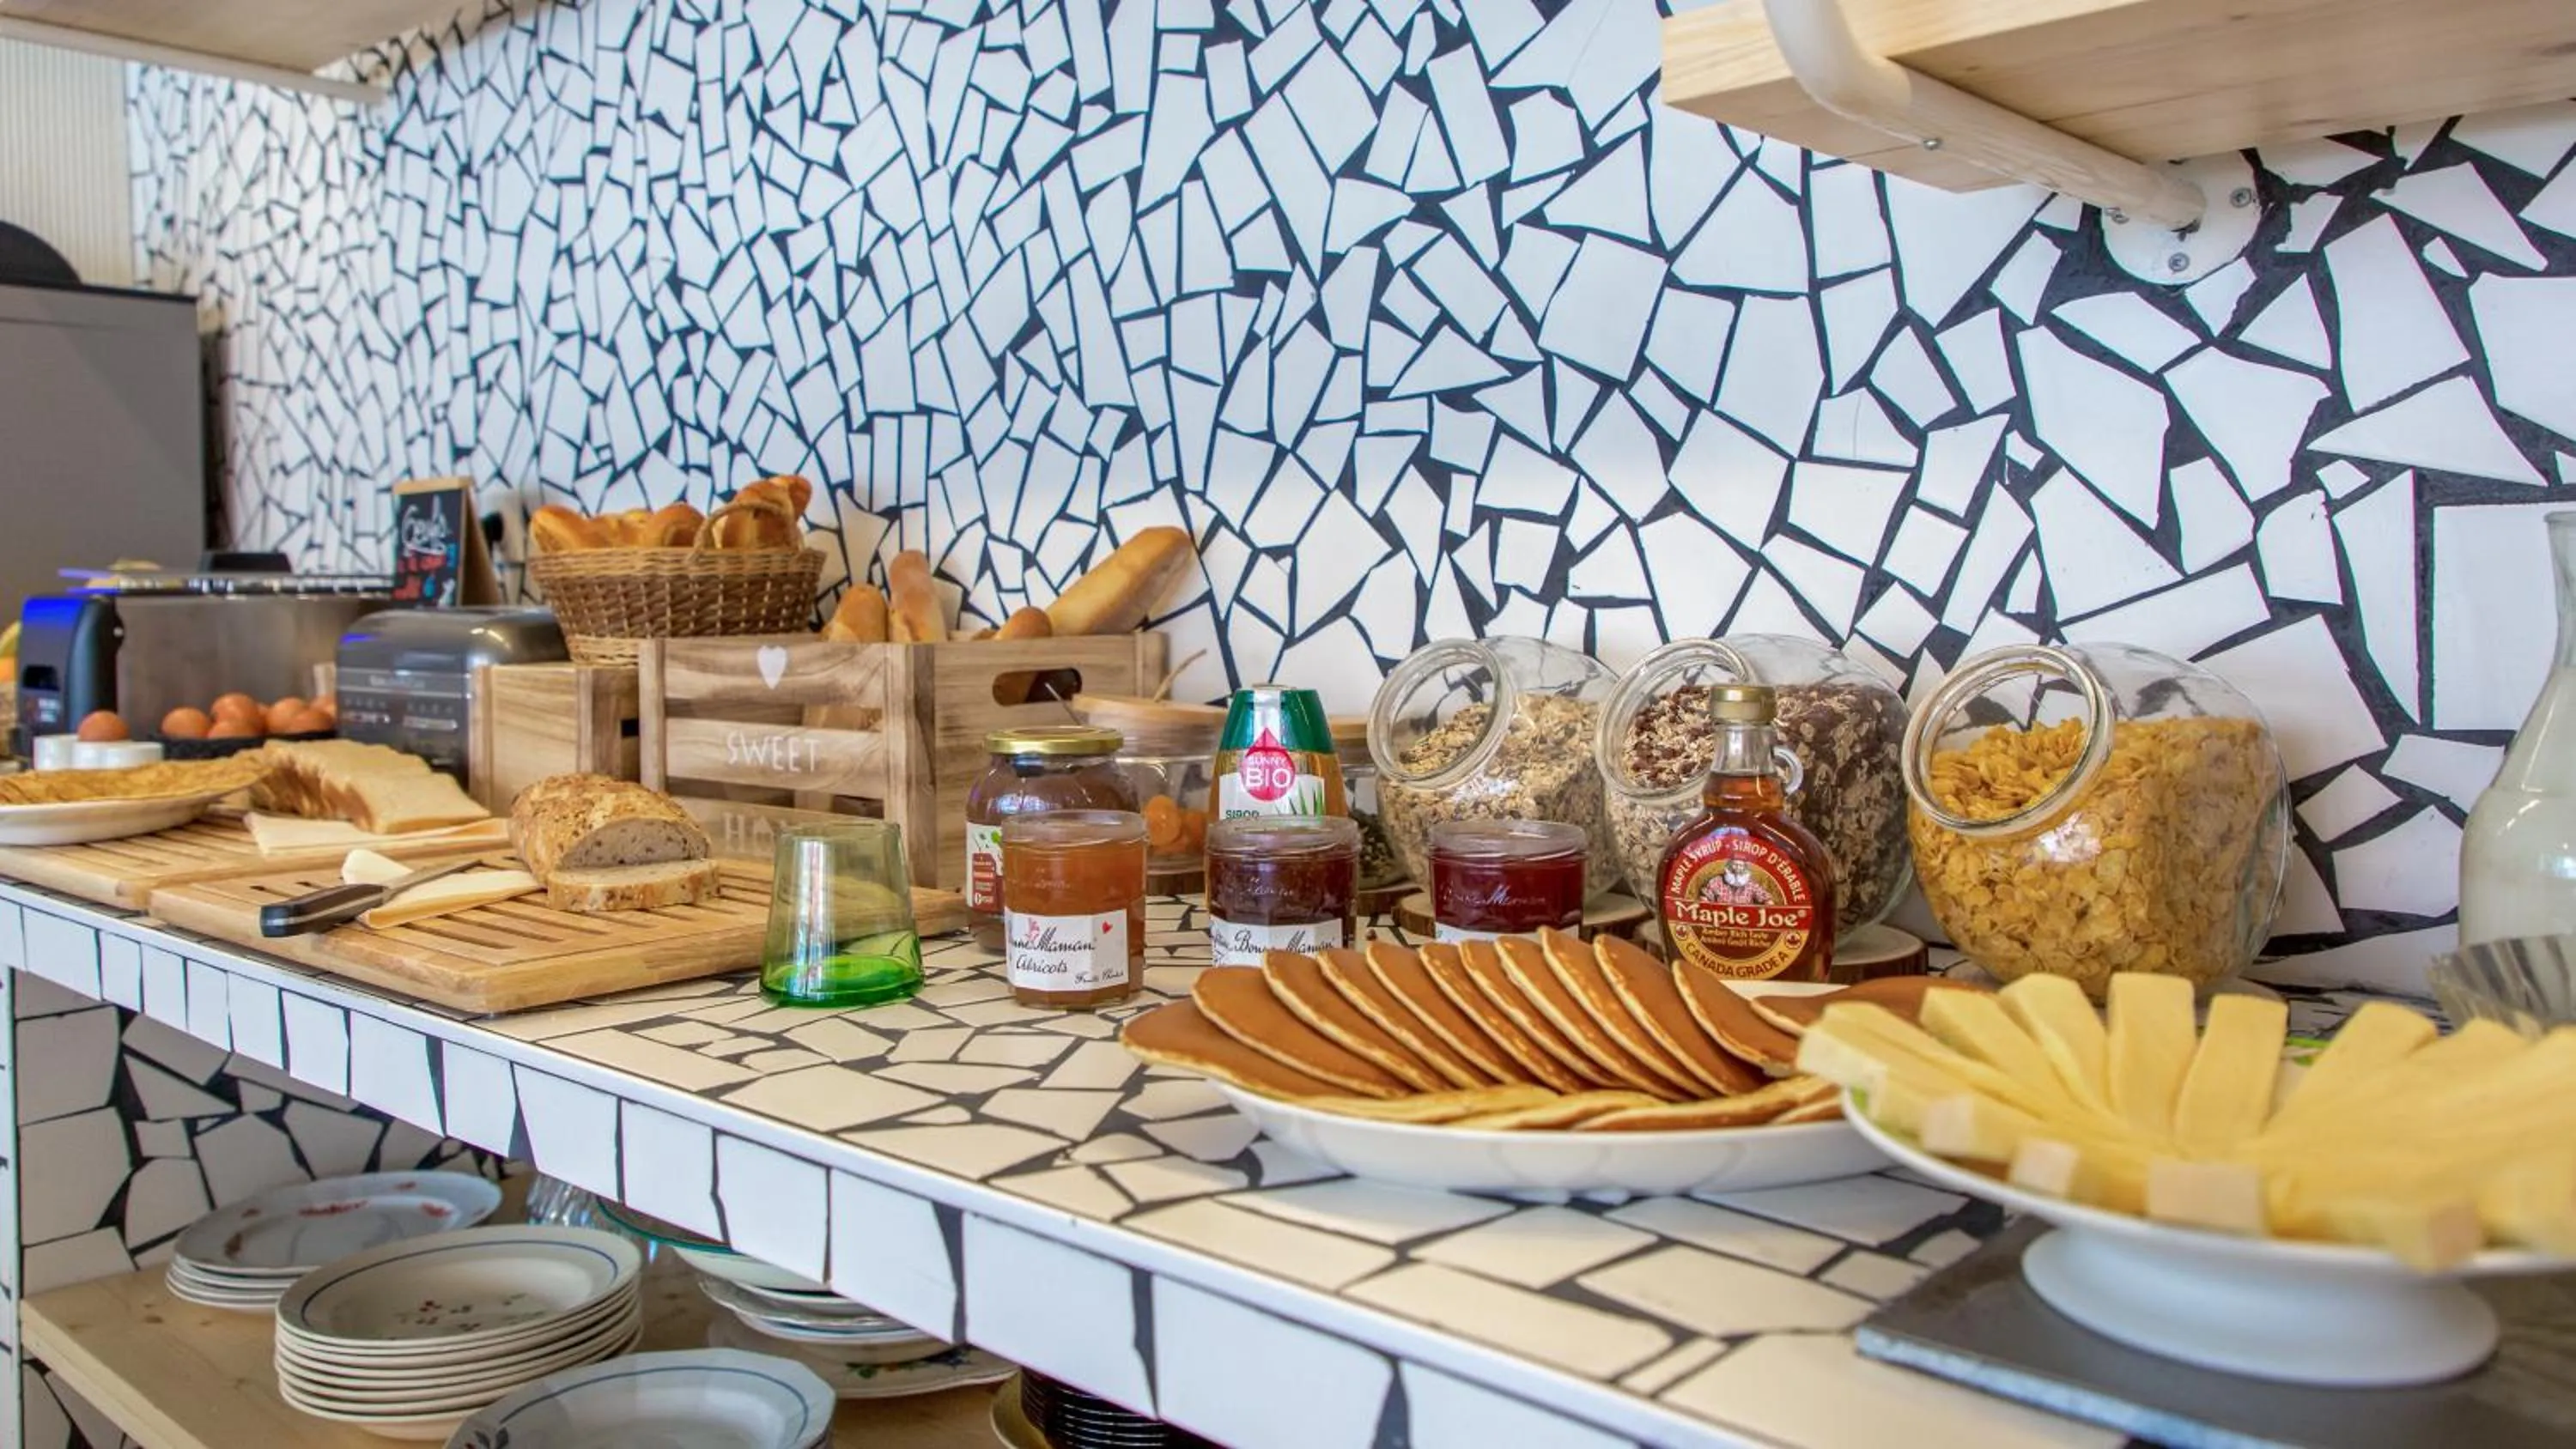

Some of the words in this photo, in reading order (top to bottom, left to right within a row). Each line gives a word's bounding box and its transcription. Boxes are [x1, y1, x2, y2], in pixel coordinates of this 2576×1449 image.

[726, 731, 820, 772] SWEET
[1246, 755, 1286, 766] SUNNY
[1245, 767, 1291, 788] BIO
[1670, 858, 1693, 894] MAPLE
[1683, 840, 1722, 863] SYRUP
[1733, 838, 1768, 857] SIROP
[1674, 900, 1749, 926] Maple
[1686, 943, 1734, 978] CANADA
[1736, 959, 1781, 978] GRADE
[1778, 950, 1789, 962] A
